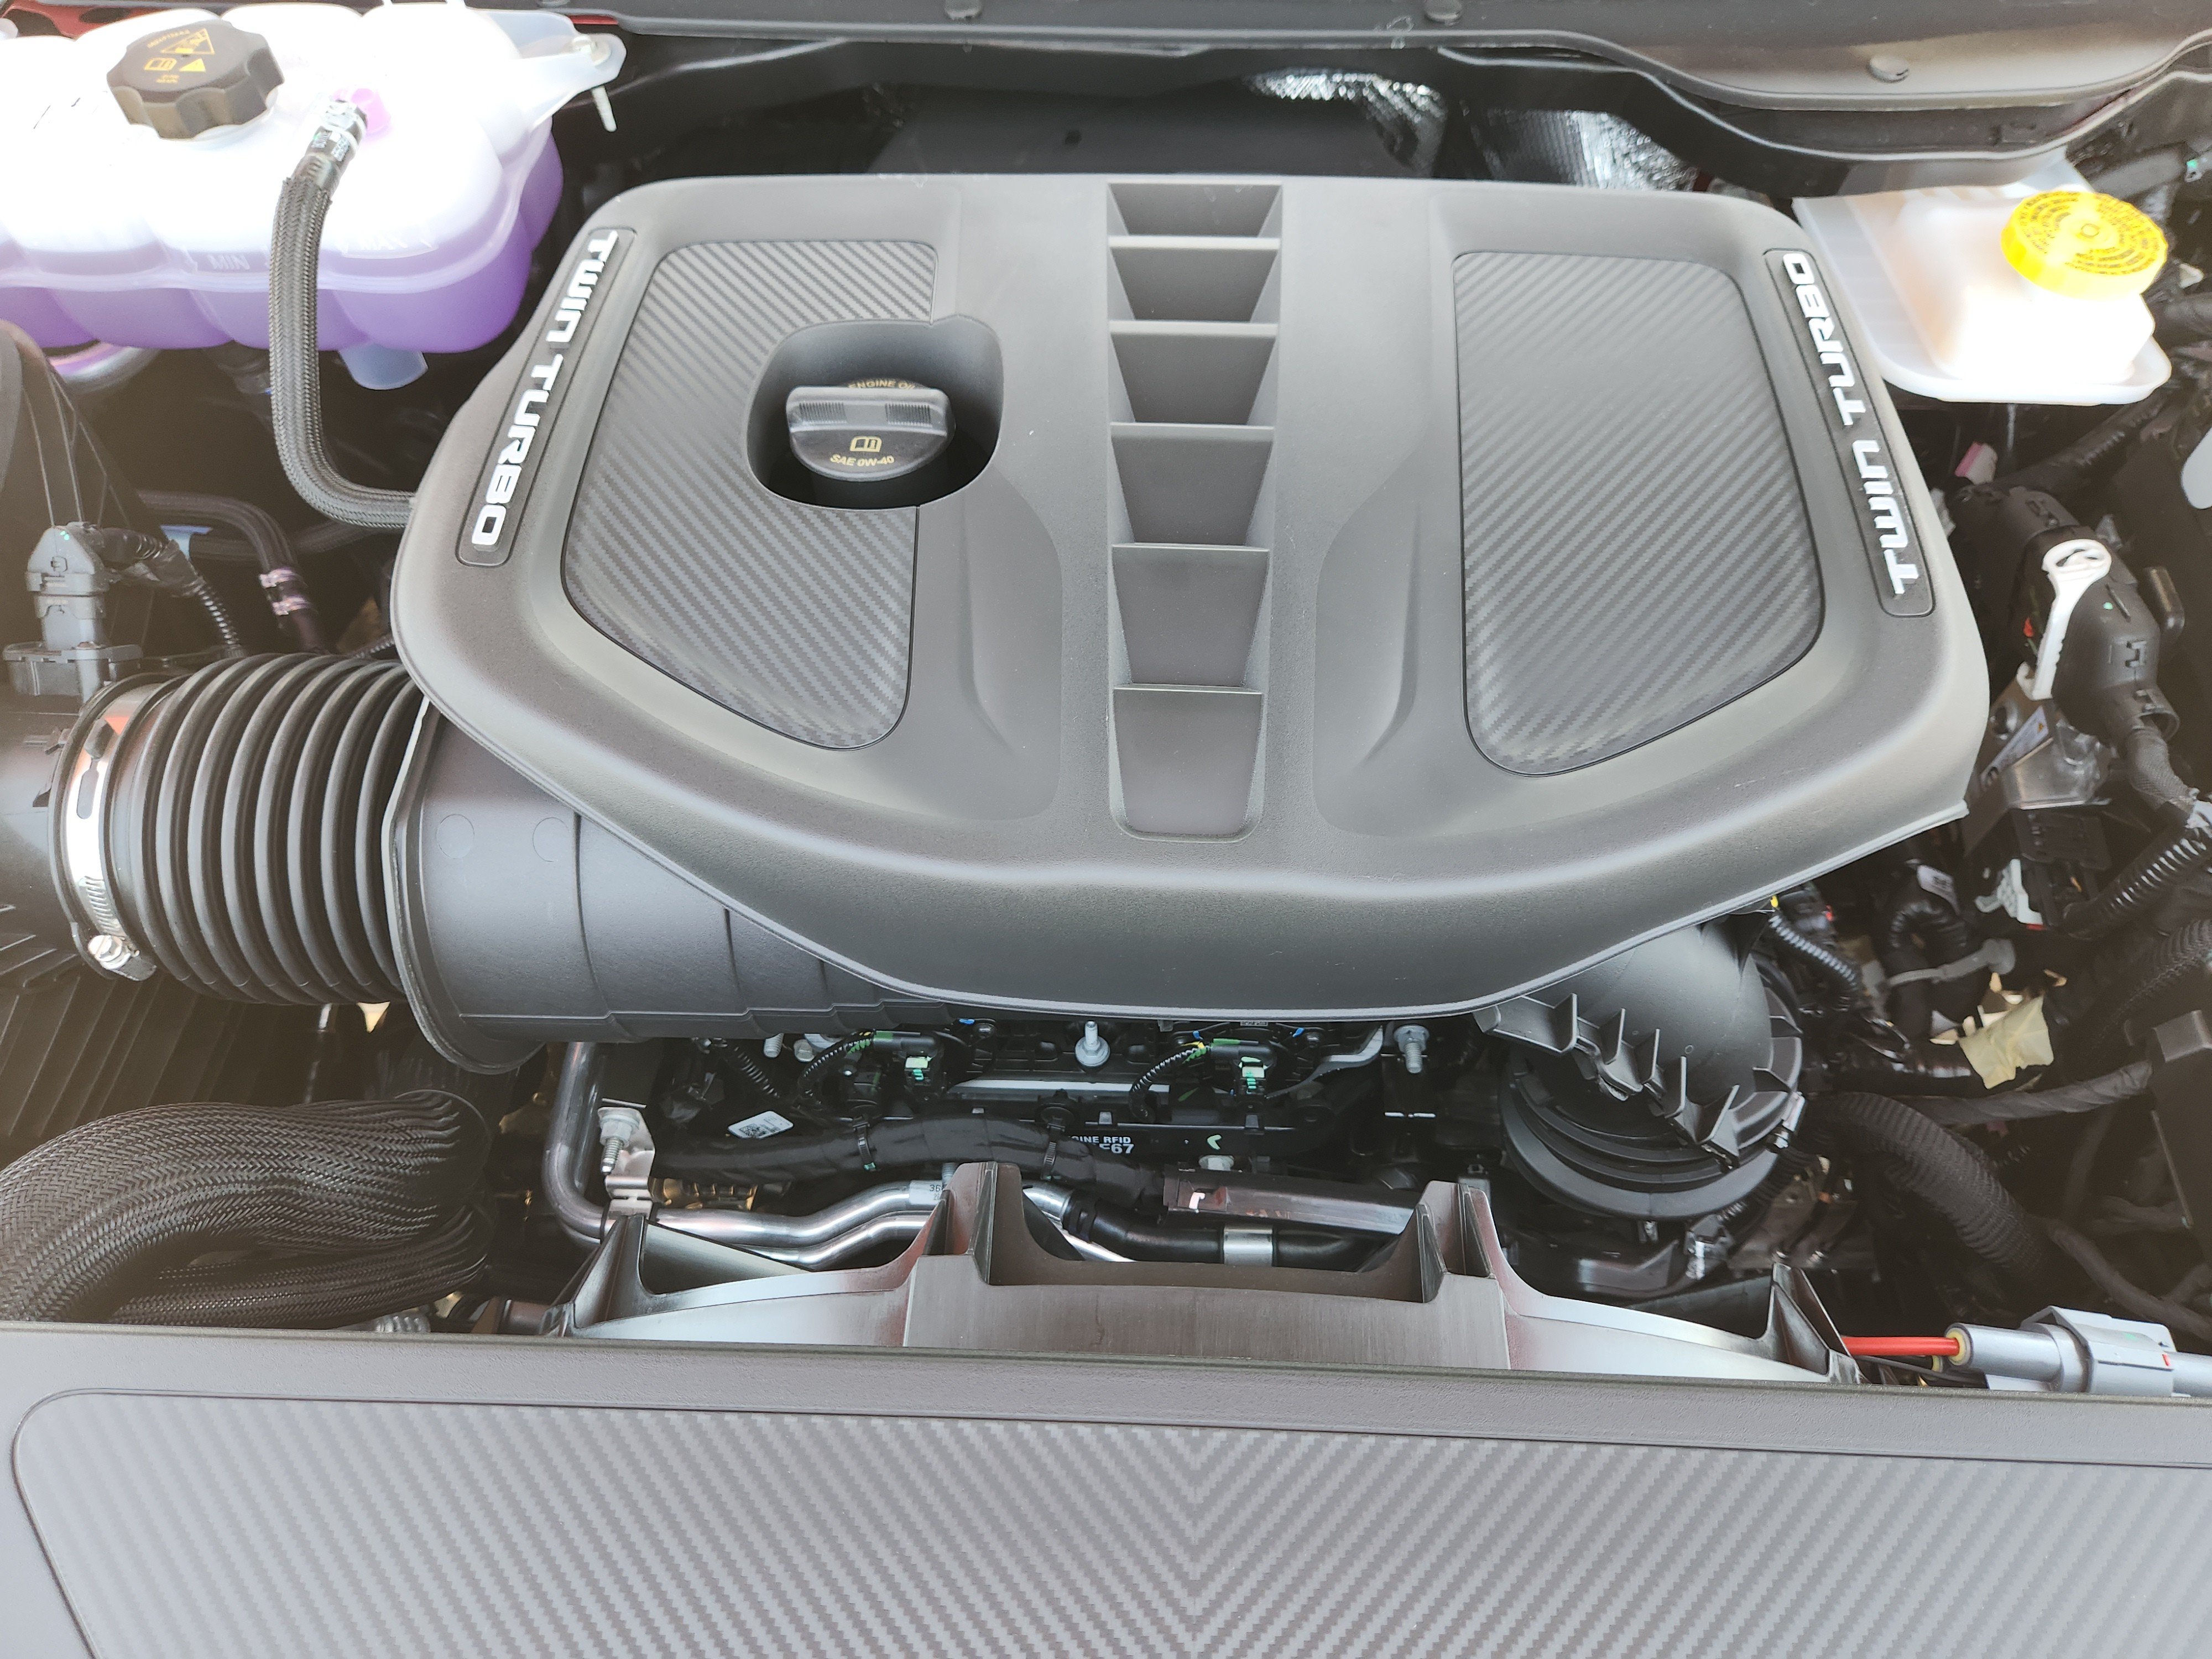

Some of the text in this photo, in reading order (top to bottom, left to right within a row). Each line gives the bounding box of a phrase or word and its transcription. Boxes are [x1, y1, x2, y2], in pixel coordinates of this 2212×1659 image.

[207, 255, 251, 270] MIN
[472, 230, 618, 545] TWIN TURBO
[848, 379, 896, 389] ENGINE
[1783, 253, 1919, 594] TWIN TURBO
[830, 454, 895, 467] SAE 0W-40
